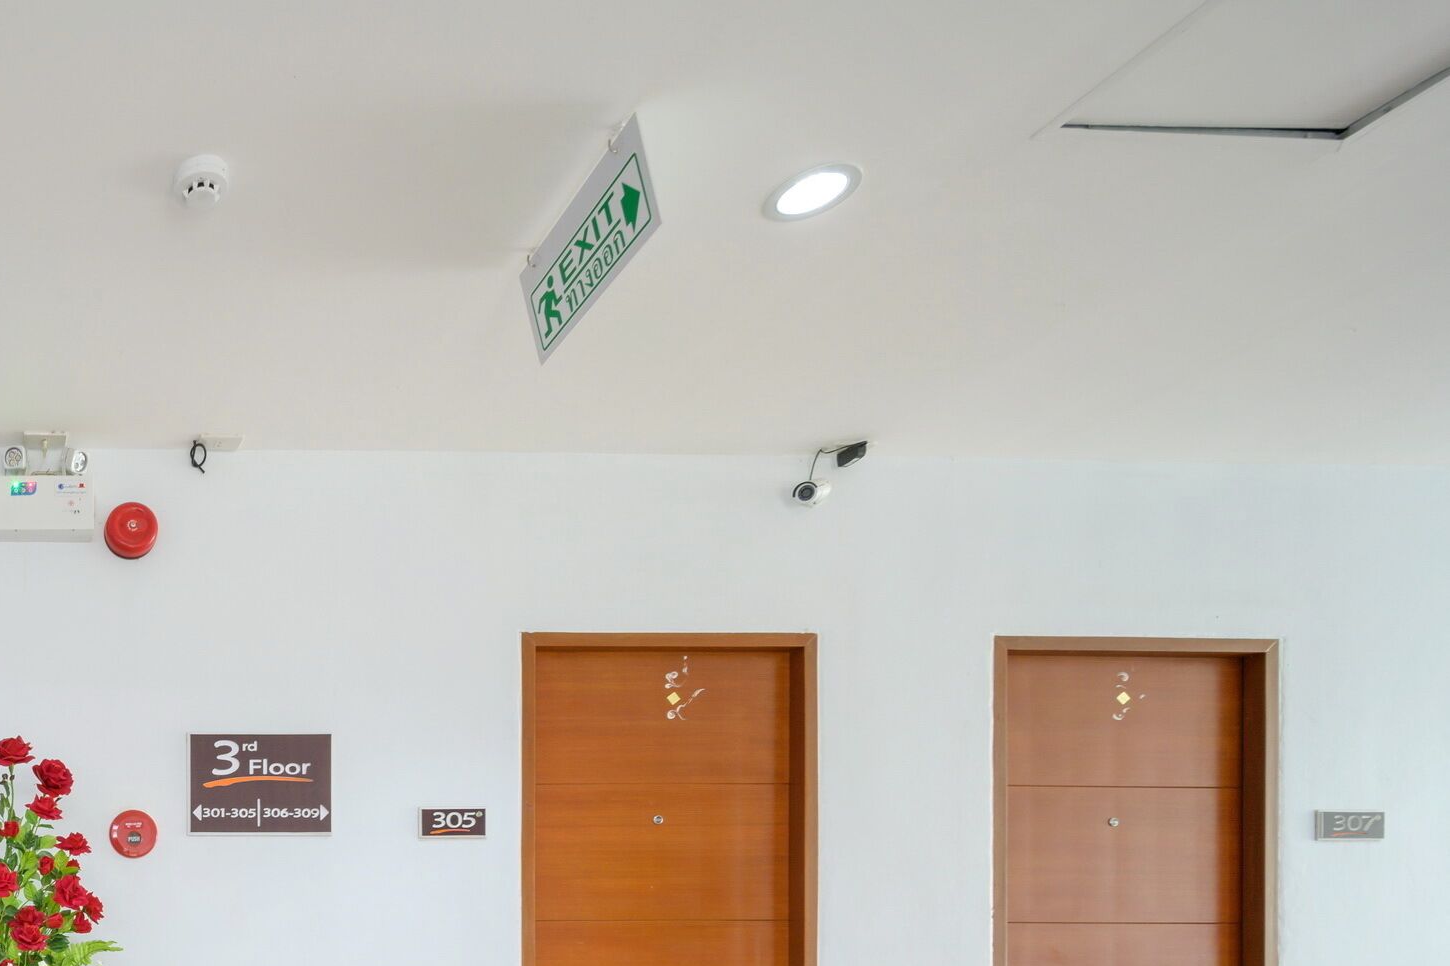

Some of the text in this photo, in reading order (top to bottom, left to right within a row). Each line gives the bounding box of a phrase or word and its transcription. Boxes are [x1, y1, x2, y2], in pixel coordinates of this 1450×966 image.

[558, 191, 615, 285] EXIT
[565, 229, 627, 313] ทางออก
[248, 758, 312, 776] Floor
[202, 807, 320, 819] 301-305 306-309
[431, 811, 477, 829] 305
[1333, 814, 1375, 832] 307
